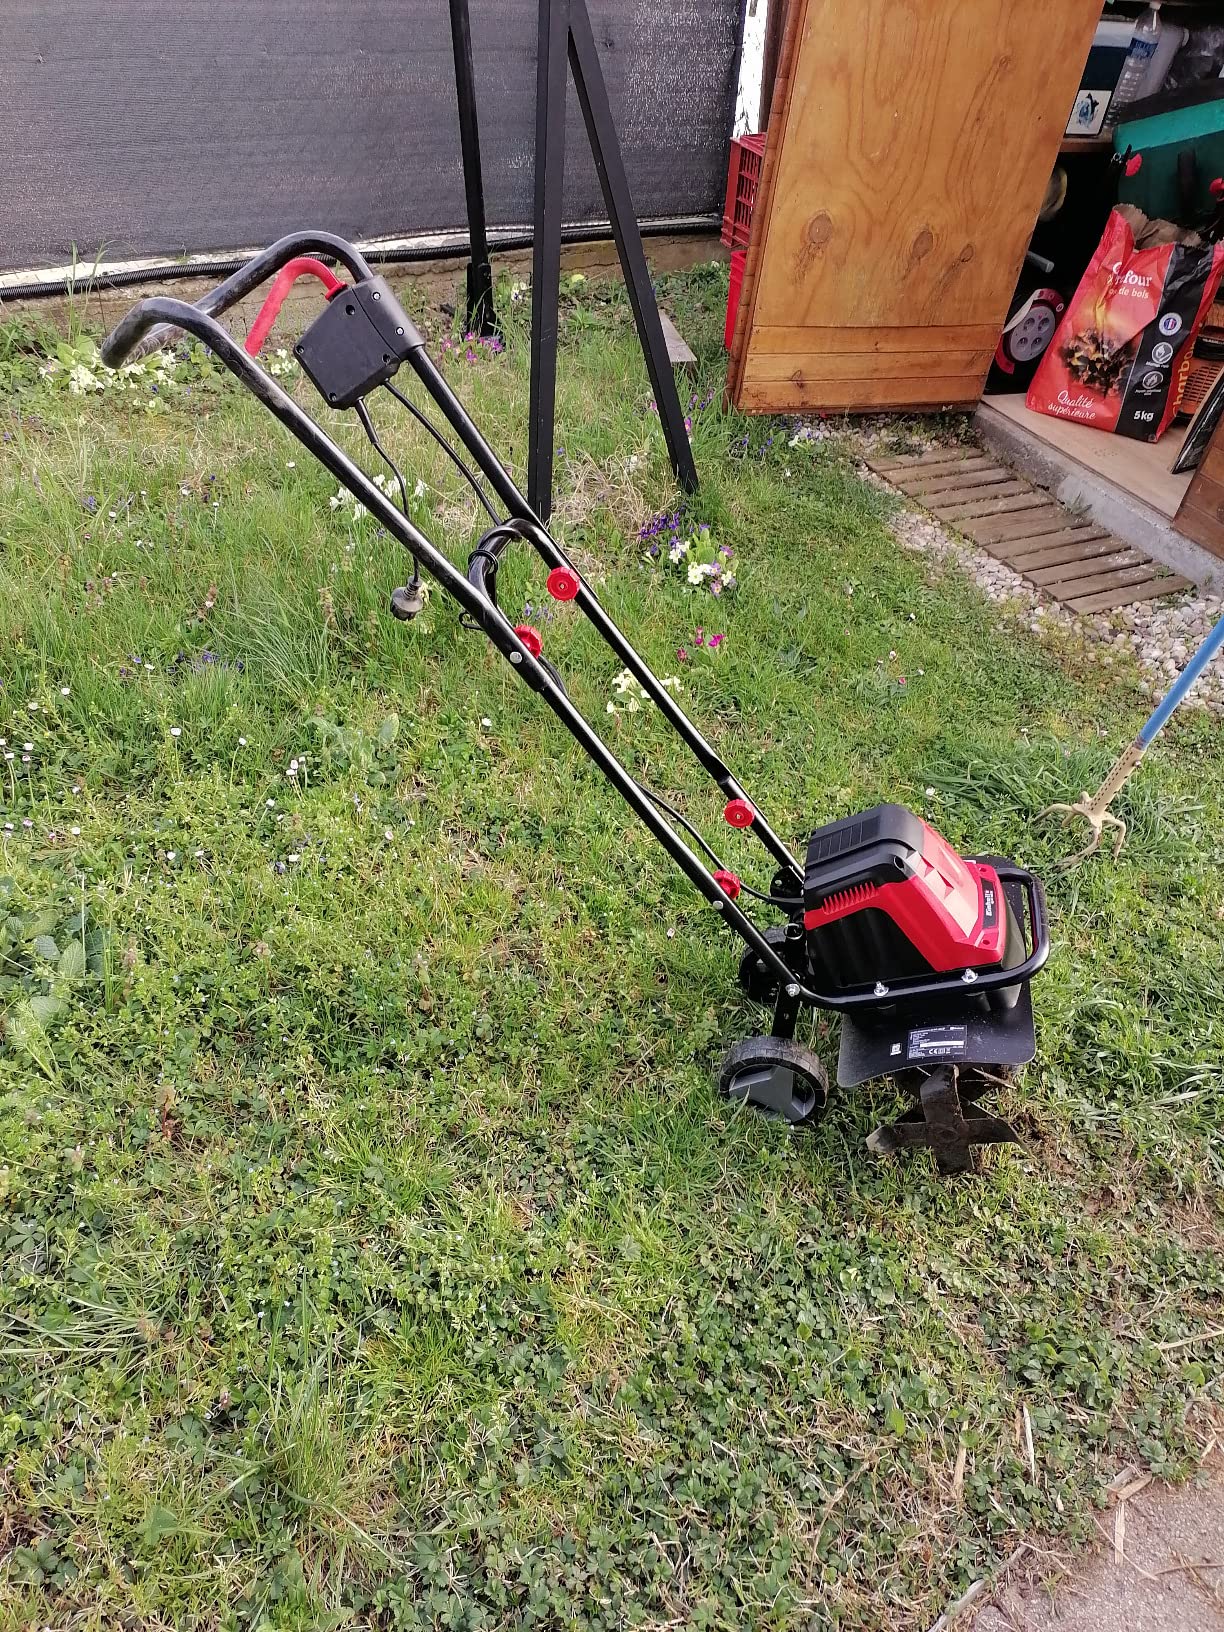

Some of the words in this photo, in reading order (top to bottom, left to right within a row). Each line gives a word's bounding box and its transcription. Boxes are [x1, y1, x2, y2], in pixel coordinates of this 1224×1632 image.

[1118, 286, 1130, 296] de
[1131, 287, 1150, 299] bois
[1057, 389, 1094, 409] Qualité
[1047, 401, 1096, 420] supérieure
